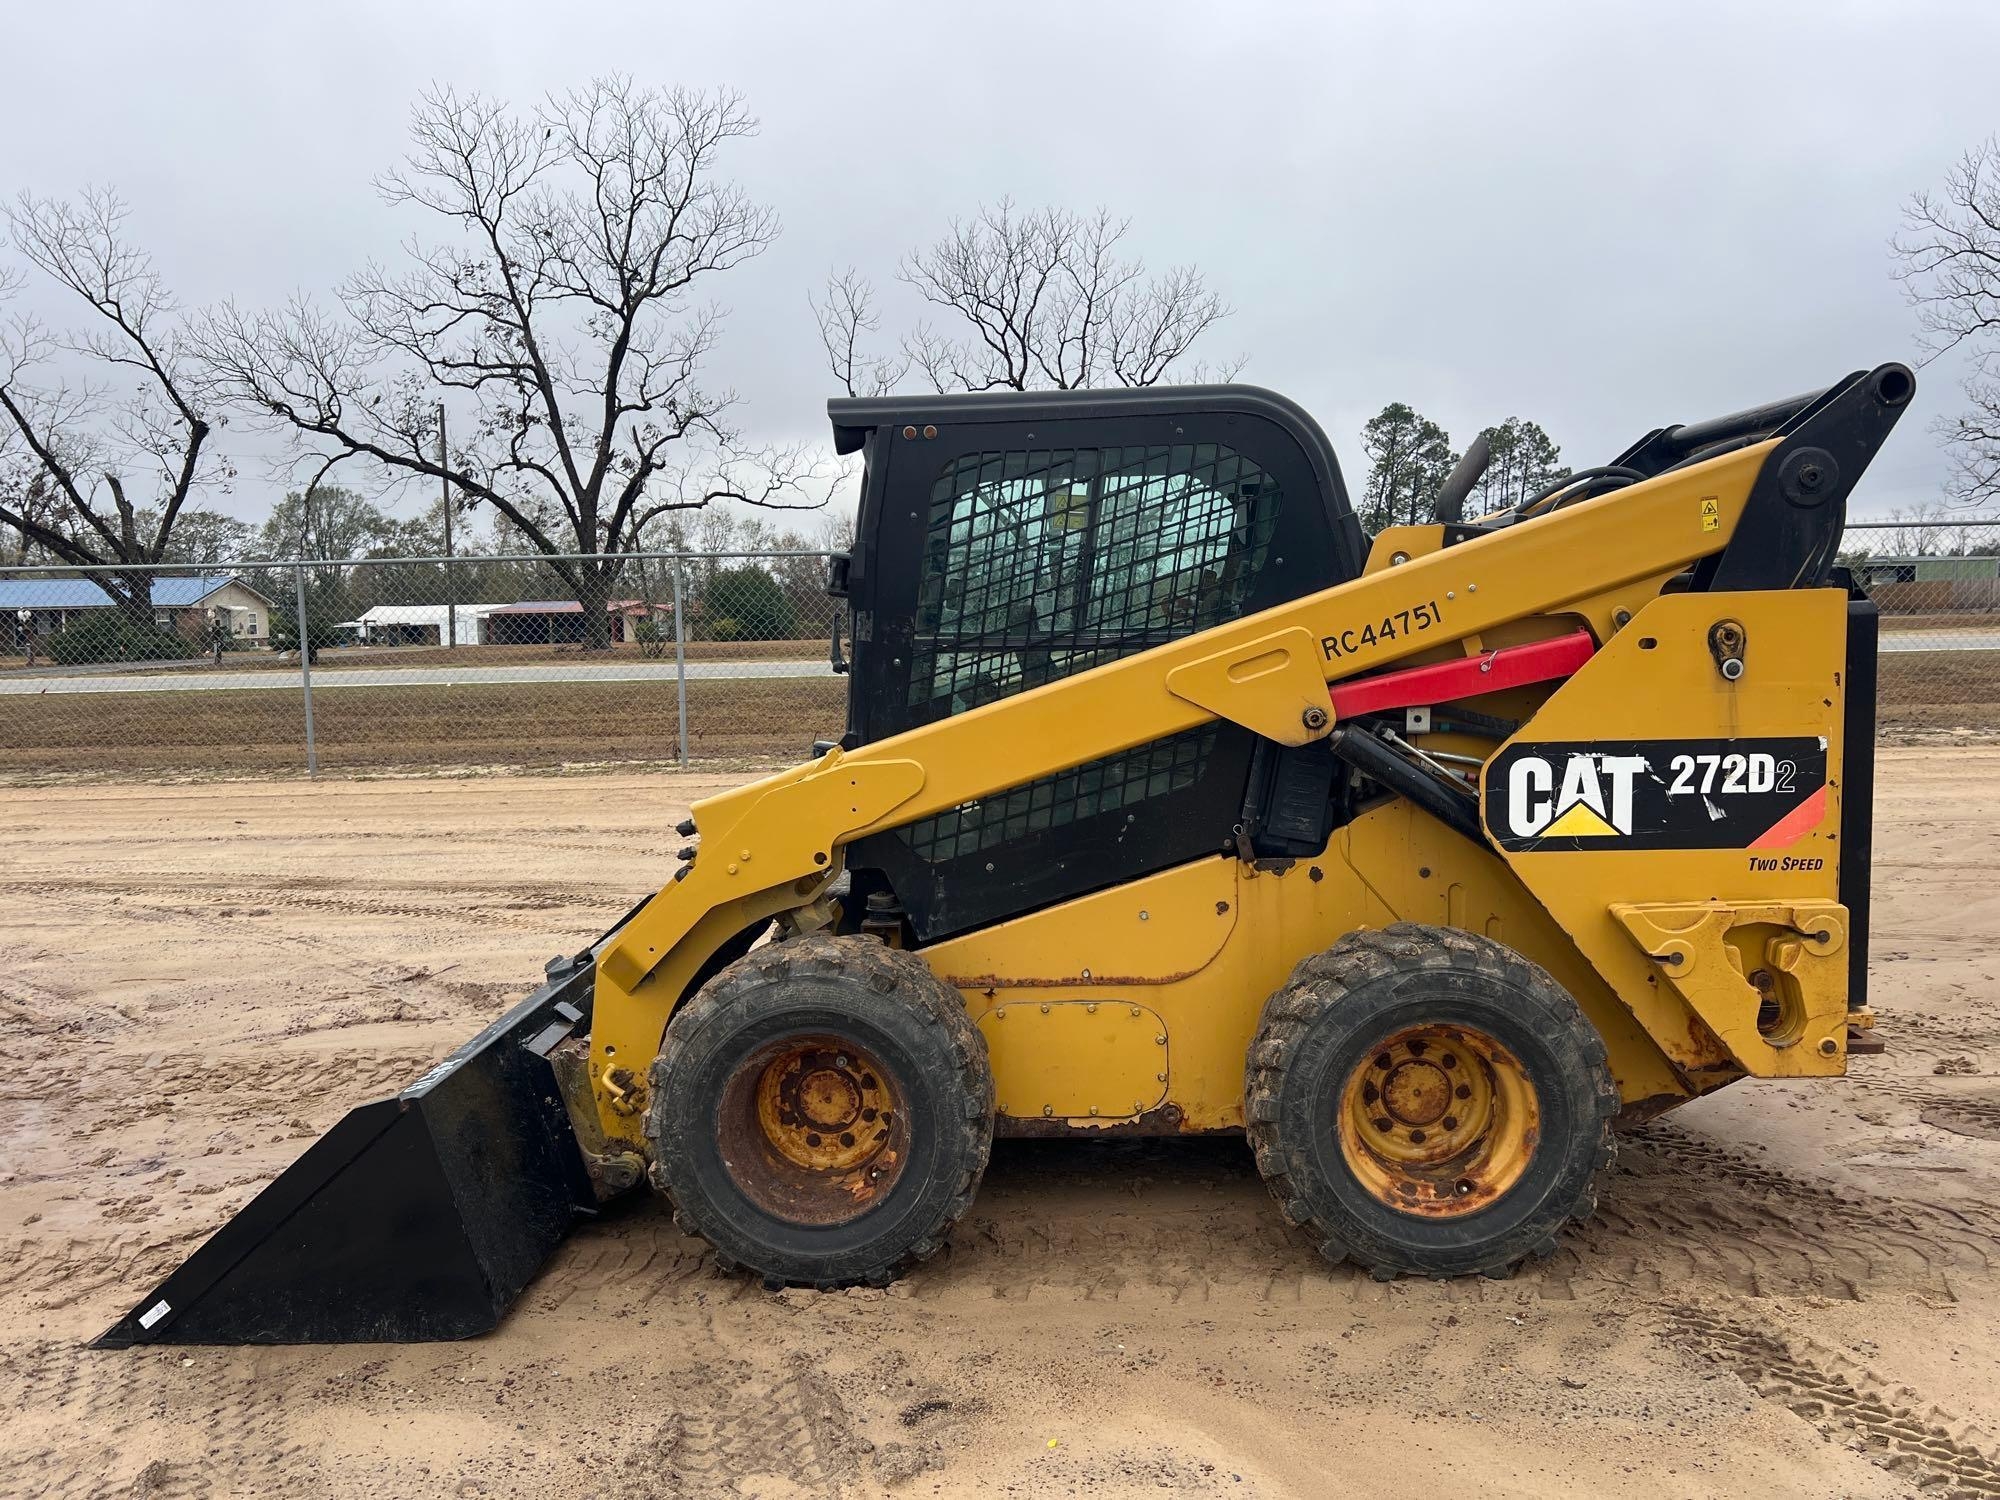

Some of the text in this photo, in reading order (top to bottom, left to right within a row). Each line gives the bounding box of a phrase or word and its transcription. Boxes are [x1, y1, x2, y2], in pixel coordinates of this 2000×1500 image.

[1321, 601, 1441, 660] RC44751
[1509, 754, 1796, 837] CAT 272D2
